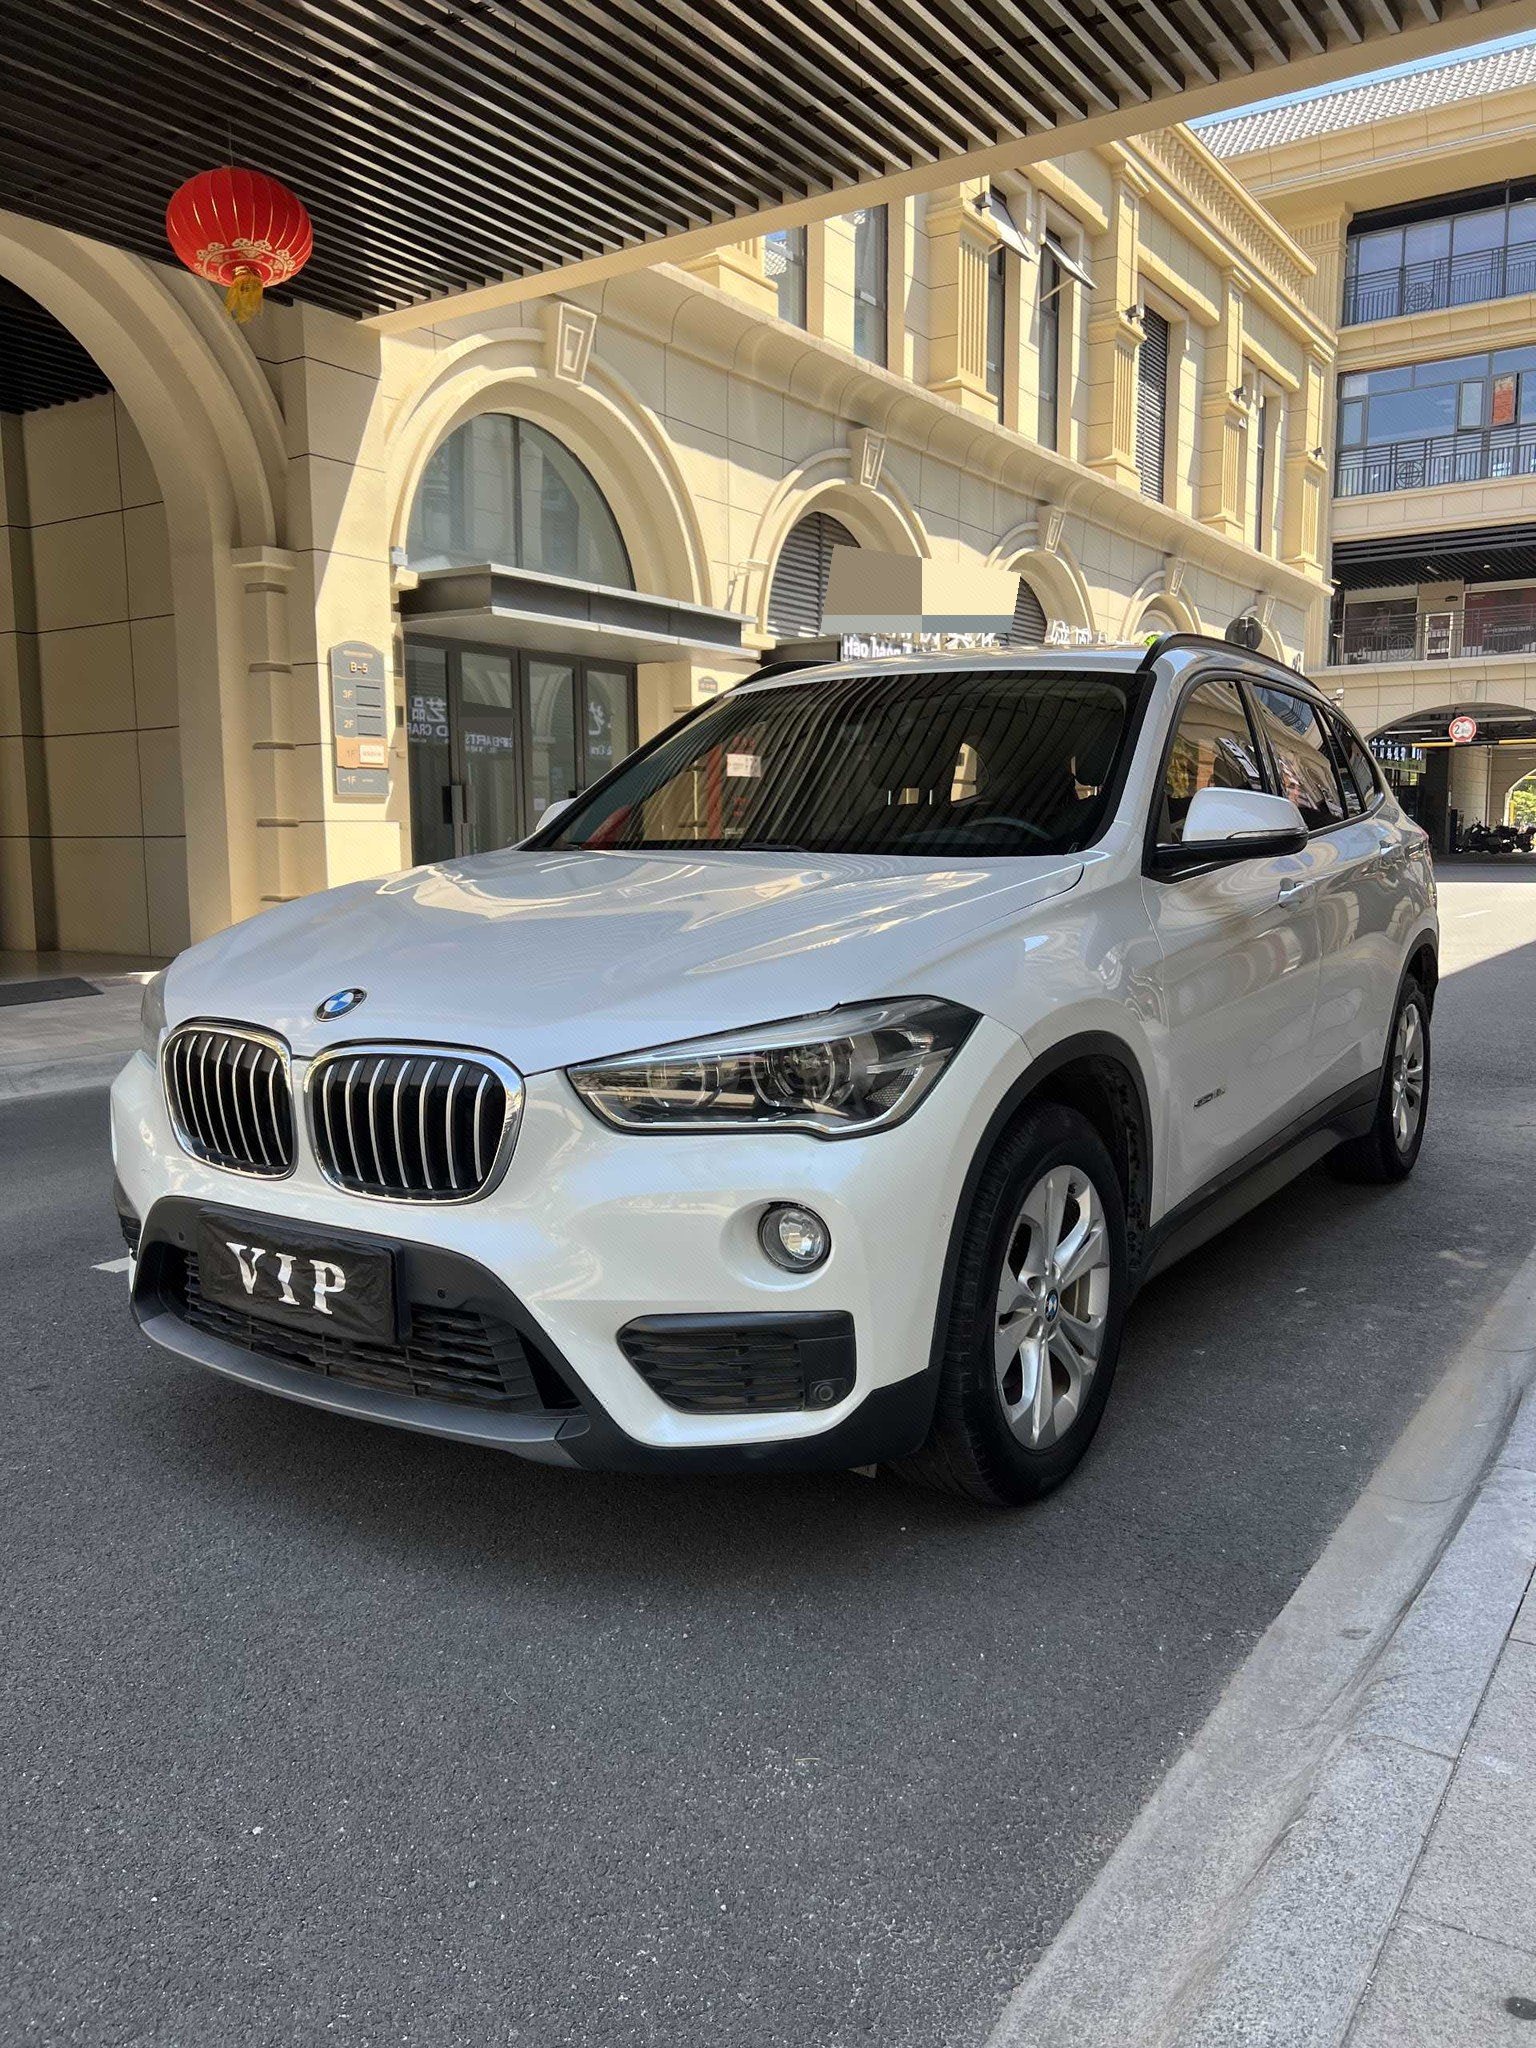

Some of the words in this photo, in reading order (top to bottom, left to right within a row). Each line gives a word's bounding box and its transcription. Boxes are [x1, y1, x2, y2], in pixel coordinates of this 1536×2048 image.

[350, 662, 368, 673] B-5
[342, 690, 352, 699] 3F
[343, 720, 354, 728] 2F
[226, 1241, 346, 1315] VIP
